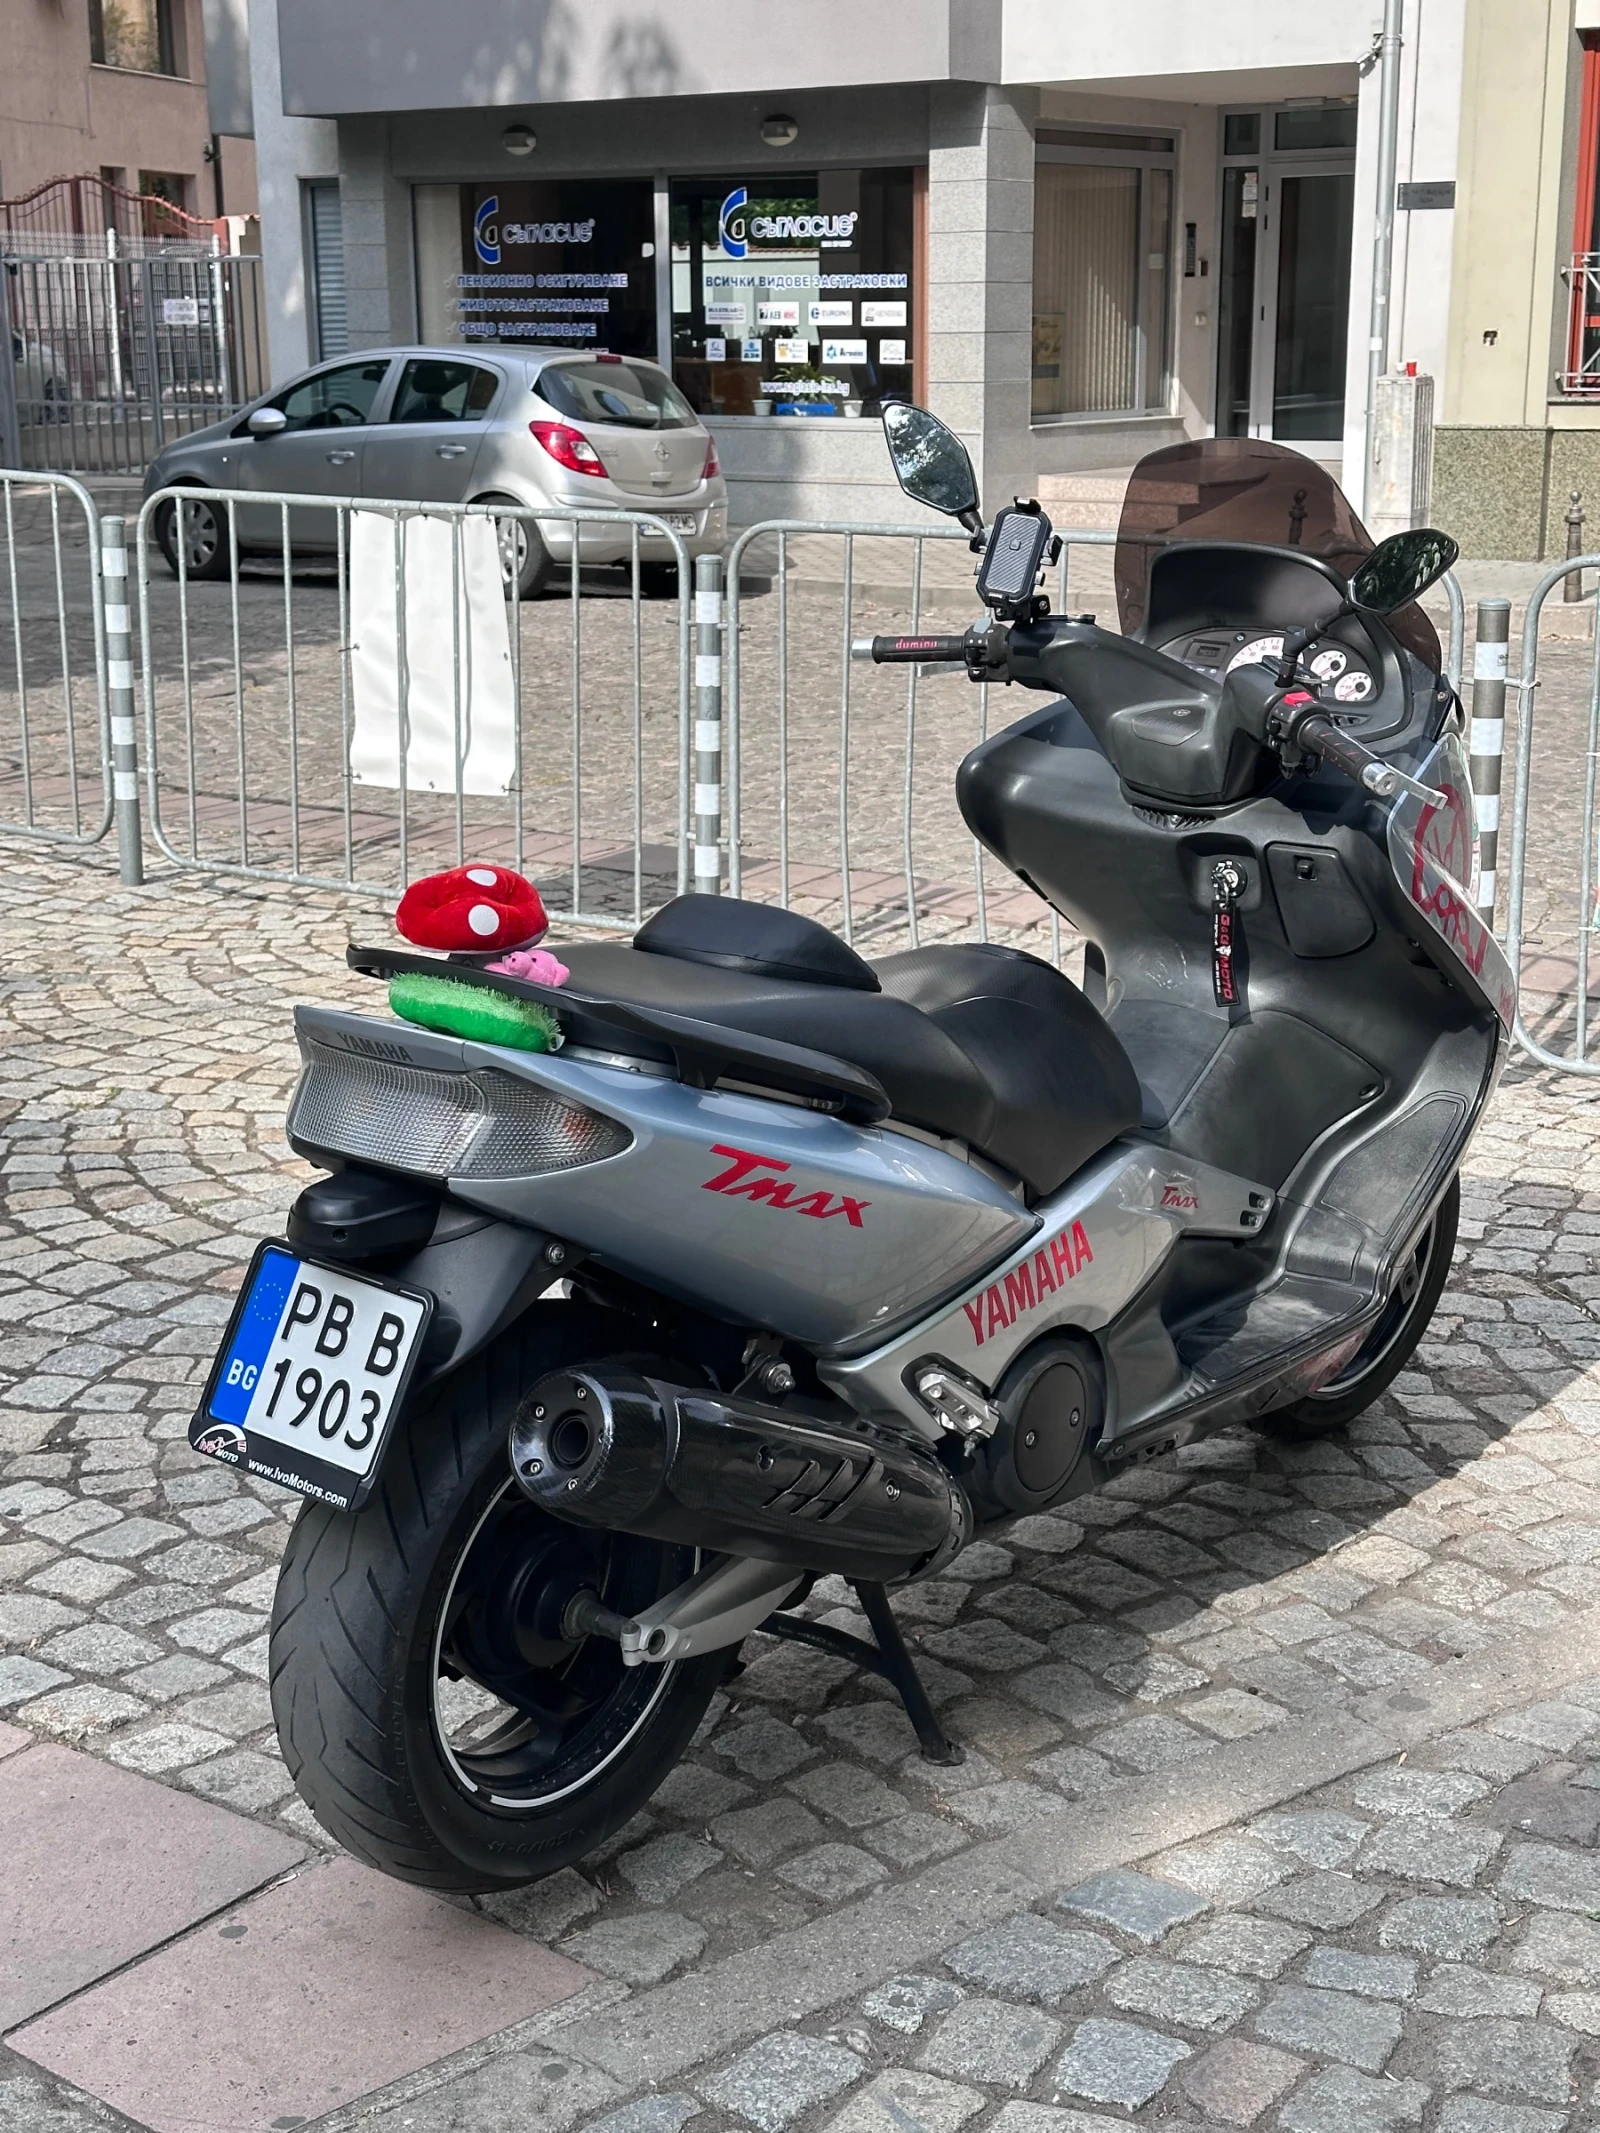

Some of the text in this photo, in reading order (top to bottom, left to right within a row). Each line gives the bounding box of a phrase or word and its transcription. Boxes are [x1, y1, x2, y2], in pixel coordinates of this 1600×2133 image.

[457, 273, 628, 288] ПЕНСИОННО ОСИГУРЯВАНЕ
[705, 273, 907, 289] ВСИЧКИ ВИДОВЕ ЗАСТРАХОВКИ
[458, 298, 609, 313] ЖИВОТОЗАСТРАХОВАНЕ
[459, 322, 597, 338] ОБЩО ЗАСТРАХОВАНЕ
[336, 1031, 414, 1063] YAMAHA
[962, 1219, 1094, 1347] YAMAHA
[281, 1282, 405, 1377] PB B
[226, 1358, 258, 1391] BG
[266, 1358, 381, 1450] 1903
